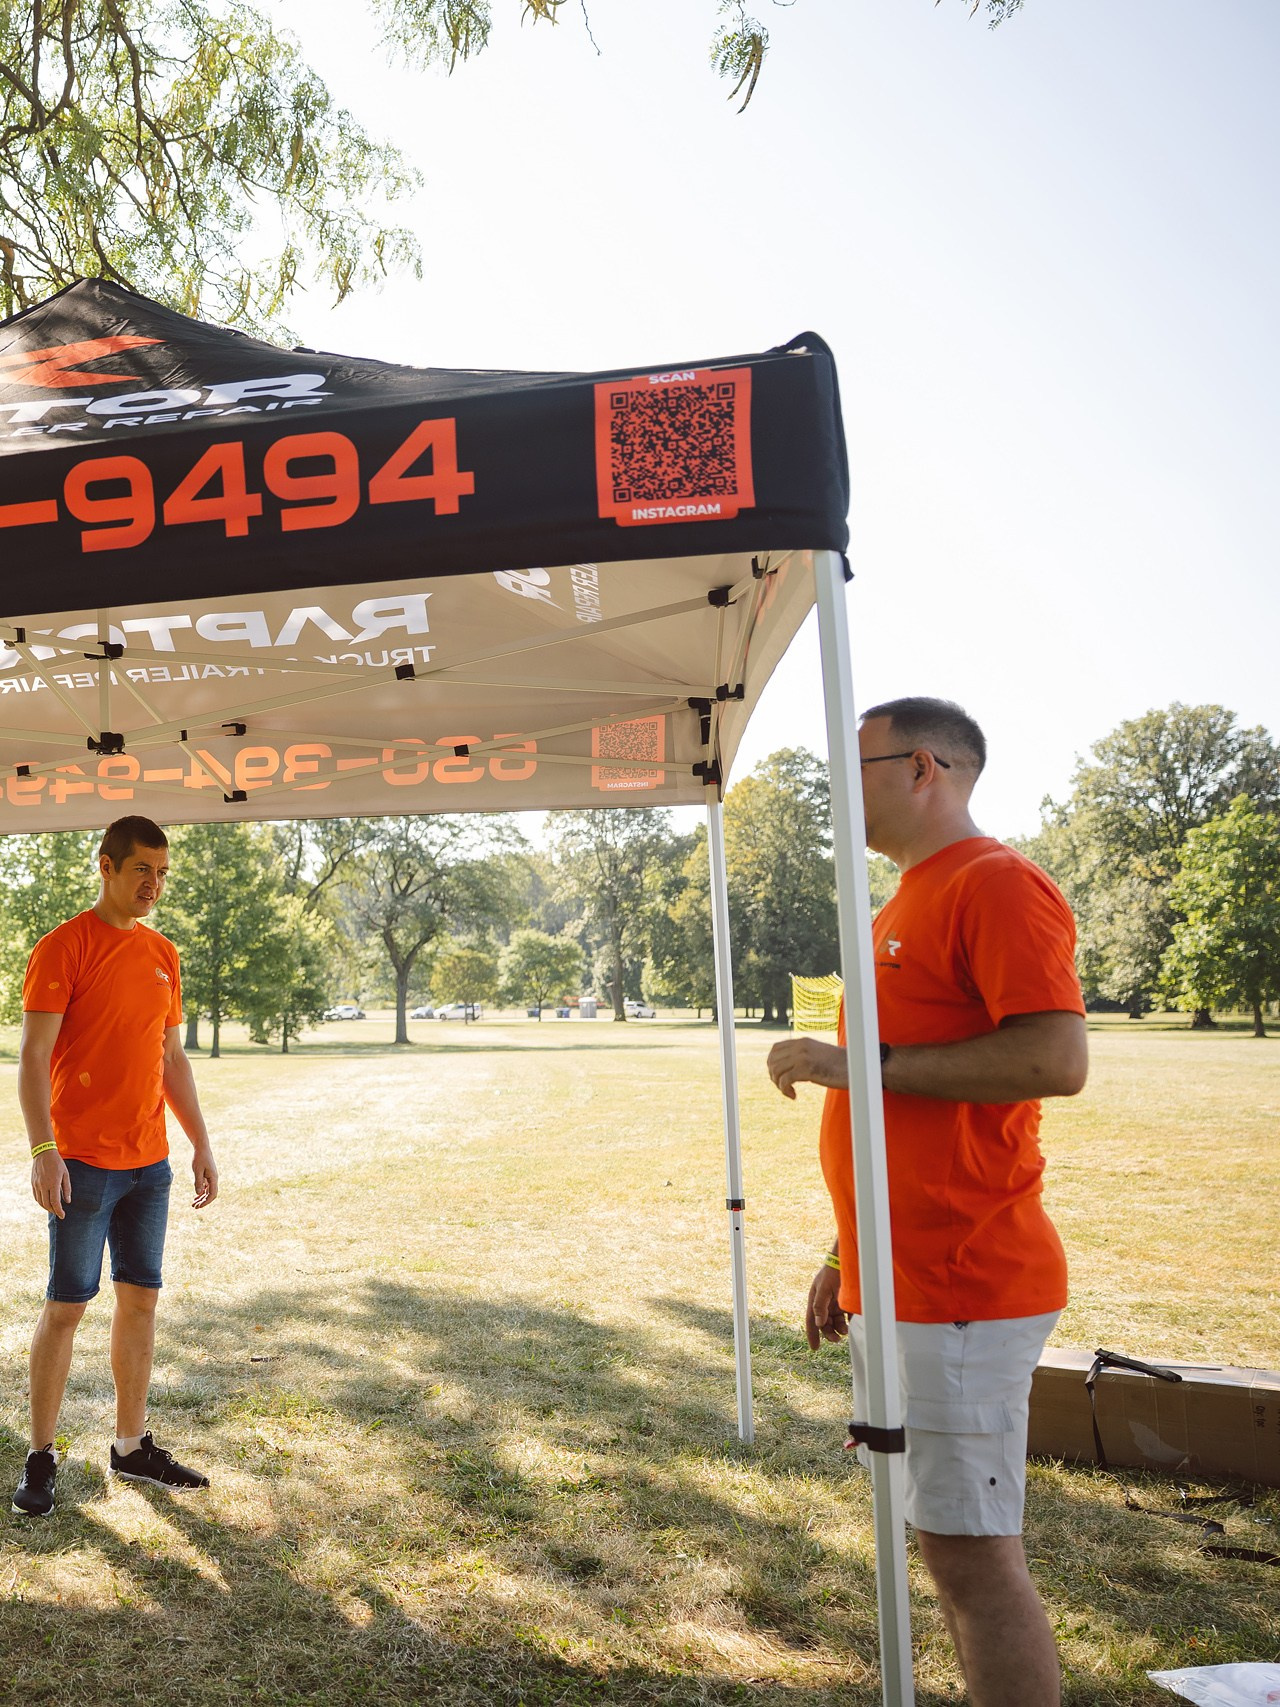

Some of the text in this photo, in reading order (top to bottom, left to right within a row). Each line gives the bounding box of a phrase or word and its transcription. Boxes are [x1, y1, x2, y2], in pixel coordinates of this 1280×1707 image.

[649, 371, 696, 384] SCAN
[102, 398, 324, 429] REPAIR
[632, 503, 721, 520] INSTAGRAM
